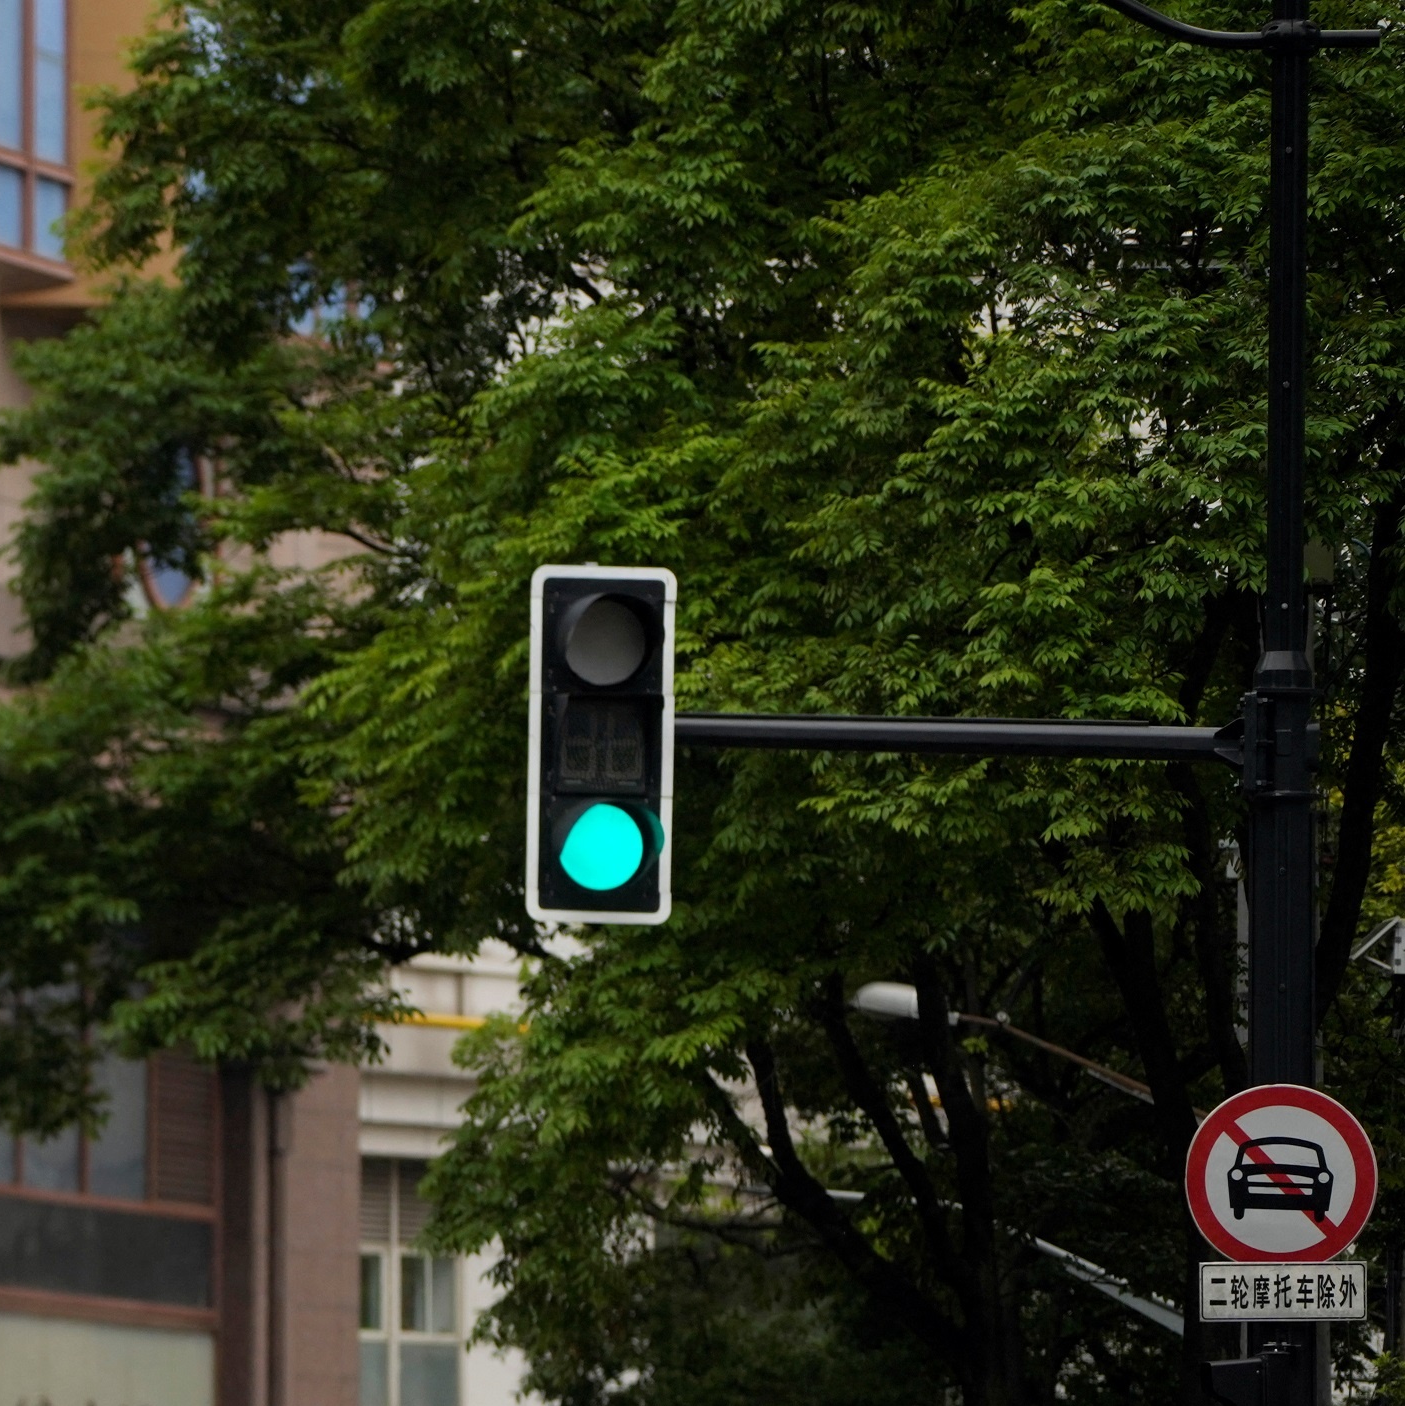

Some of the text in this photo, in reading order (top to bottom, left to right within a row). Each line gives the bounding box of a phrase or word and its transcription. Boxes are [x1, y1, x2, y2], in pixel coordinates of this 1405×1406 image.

[1209, 1273, 1358, 1309] 二轮摩托车除外
